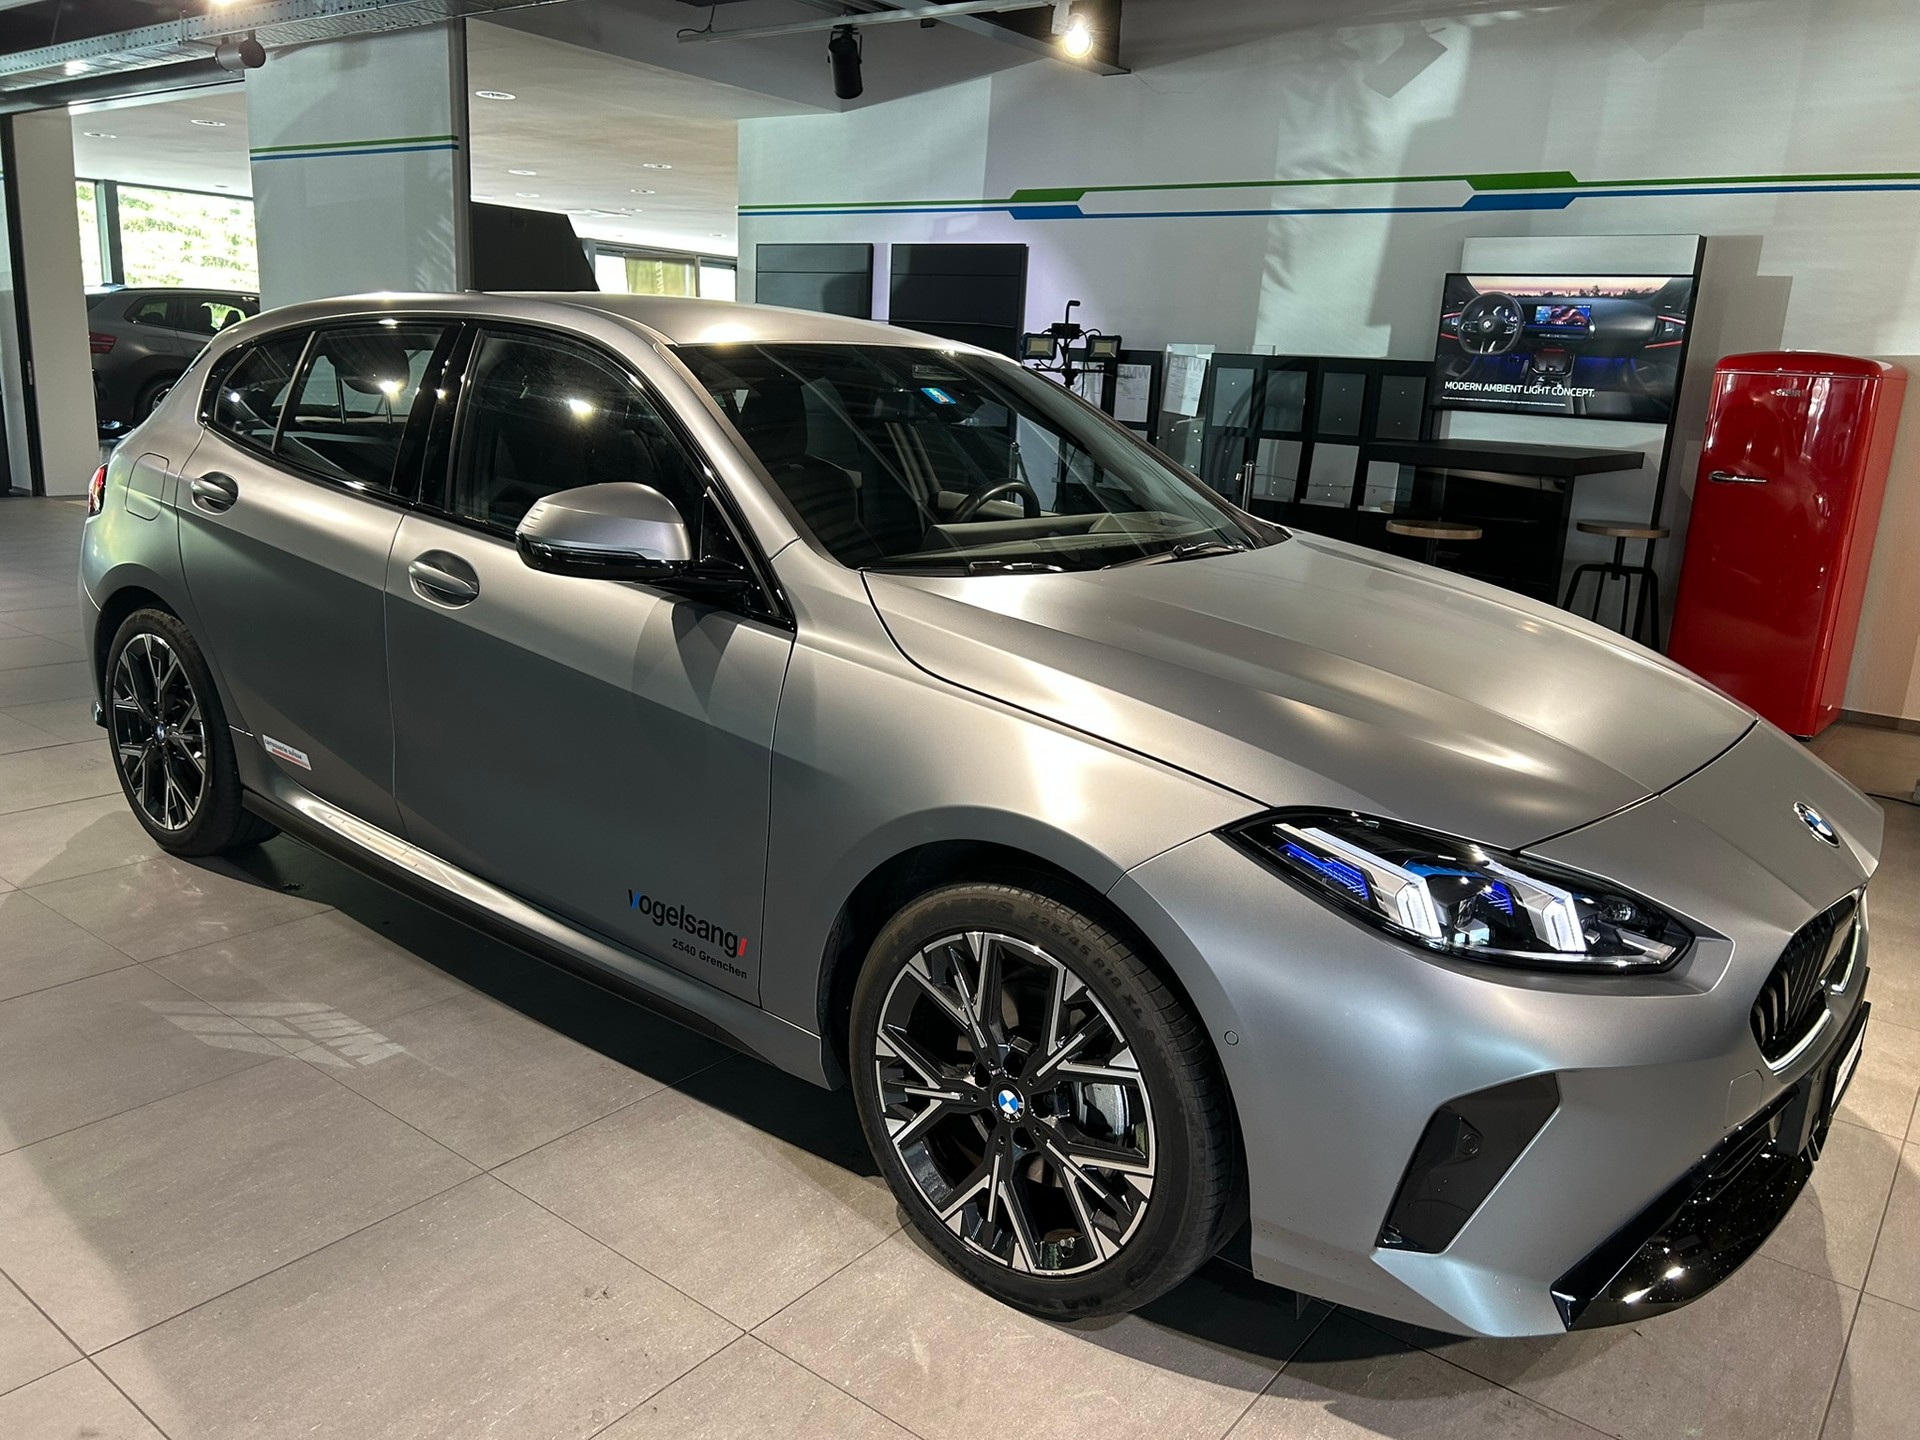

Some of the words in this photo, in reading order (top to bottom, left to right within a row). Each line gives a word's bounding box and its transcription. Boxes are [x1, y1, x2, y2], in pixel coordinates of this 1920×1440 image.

[1117, 365, 1149, 379] BMW
[1445, 381, 1482, 392] MODERN
[1483, 383, 1523, 394] AMBIENT
[1523, 385, 1551, 396] LIGHT
[1551, 387, 1595, 398] CONCEPT.
[627, 888, 739, 959] Vogelsang
[672, 937, 696, 957] 2540
[698, 950, 748, 980] Grenchen
[1028, 911, 1092, 957] 225/45
[1093, 957, 1123, 989] R18
[1122, 993, 1144, 1020] XL
